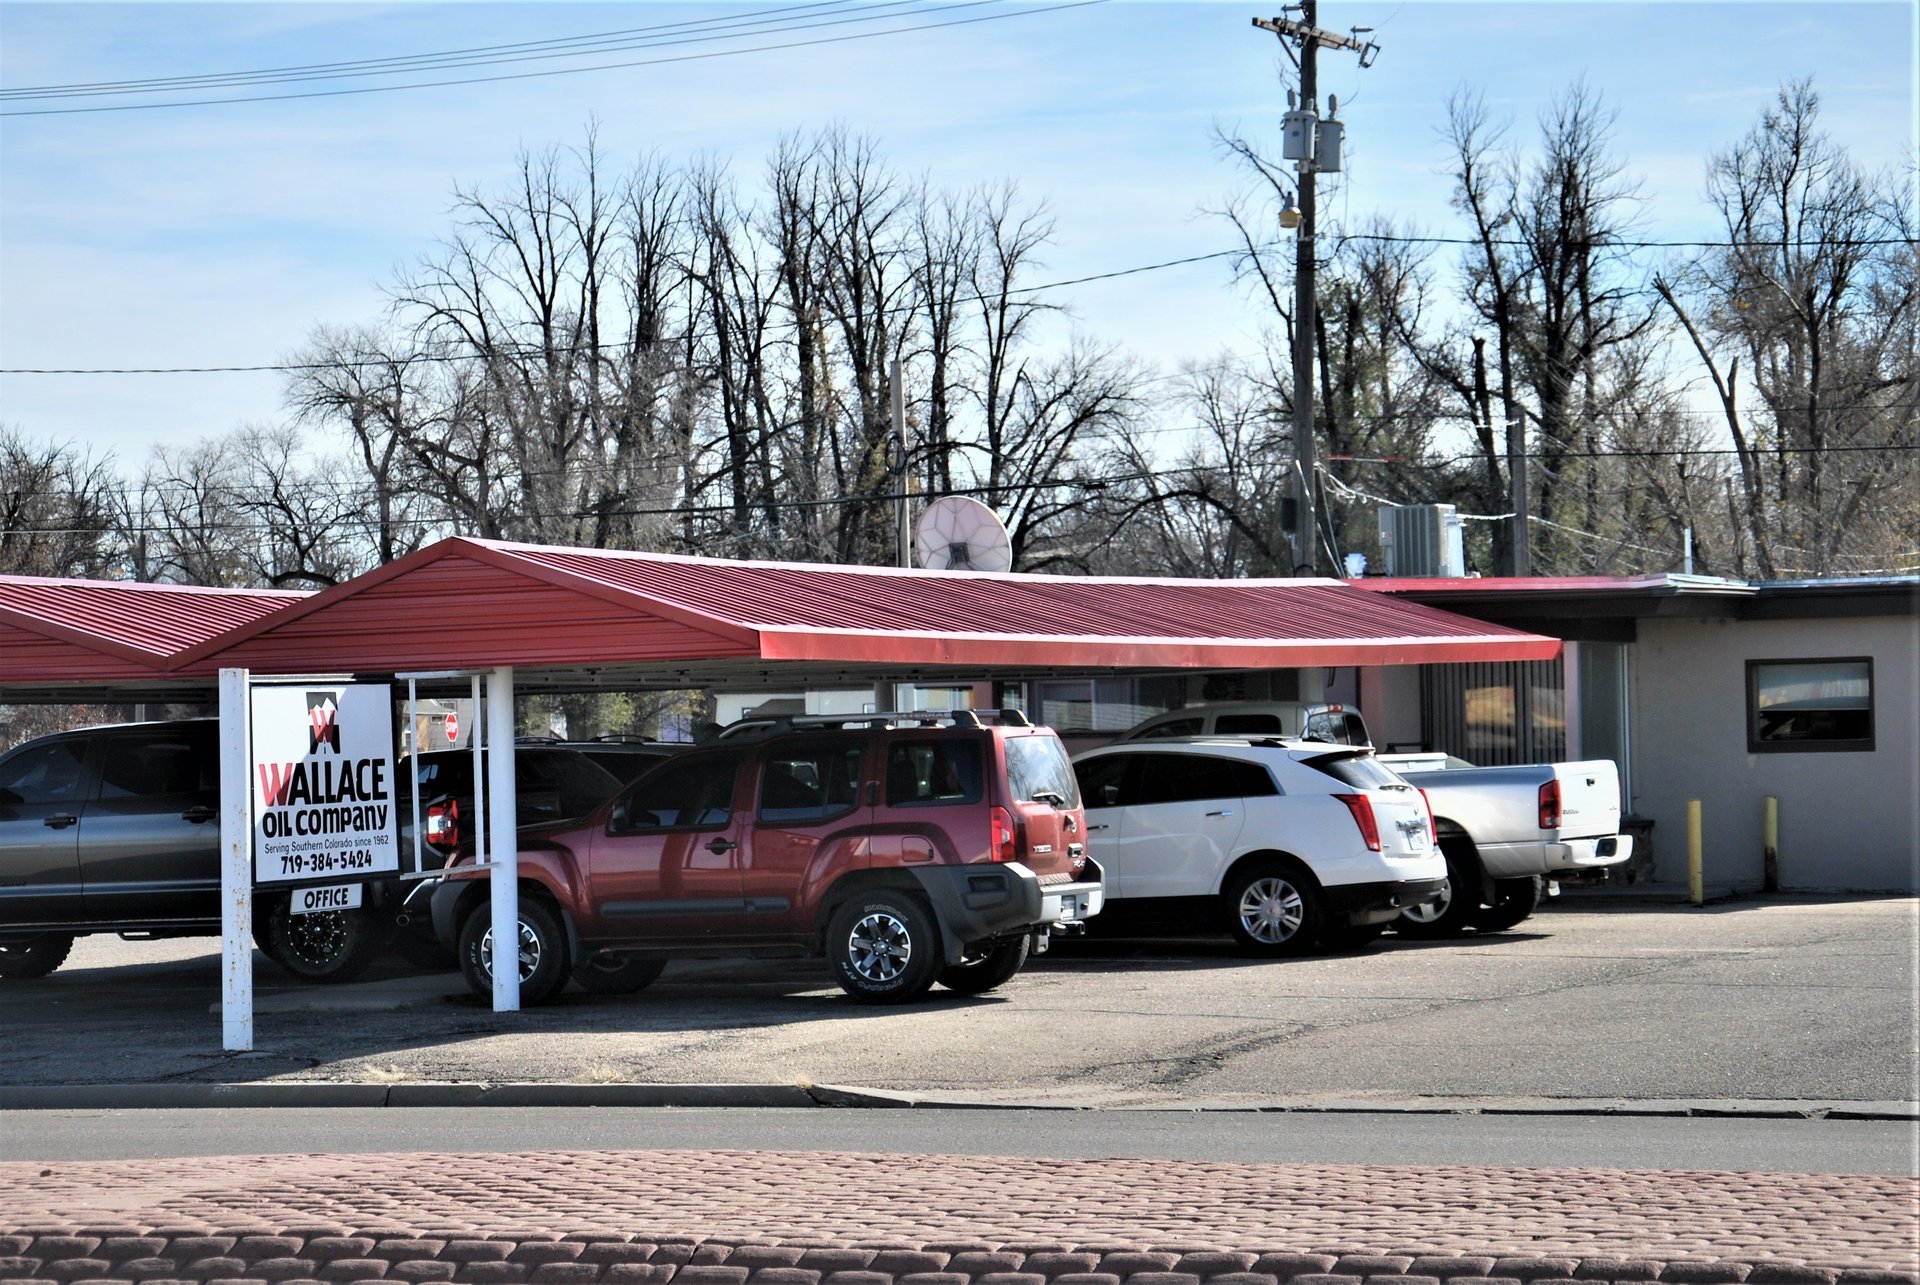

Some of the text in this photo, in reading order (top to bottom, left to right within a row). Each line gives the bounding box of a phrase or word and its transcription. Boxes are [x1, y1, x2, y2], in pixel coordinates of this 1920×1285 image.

[259, 758, 387, 807] WALLACE
[262, 810, 293, 839] OIL
[264, 835, 389, 855] Serving Southern Colorado since 1962
[280, 849, 373, 875] 719-384-5424
[303, 887, 349, 909] OFFICE
